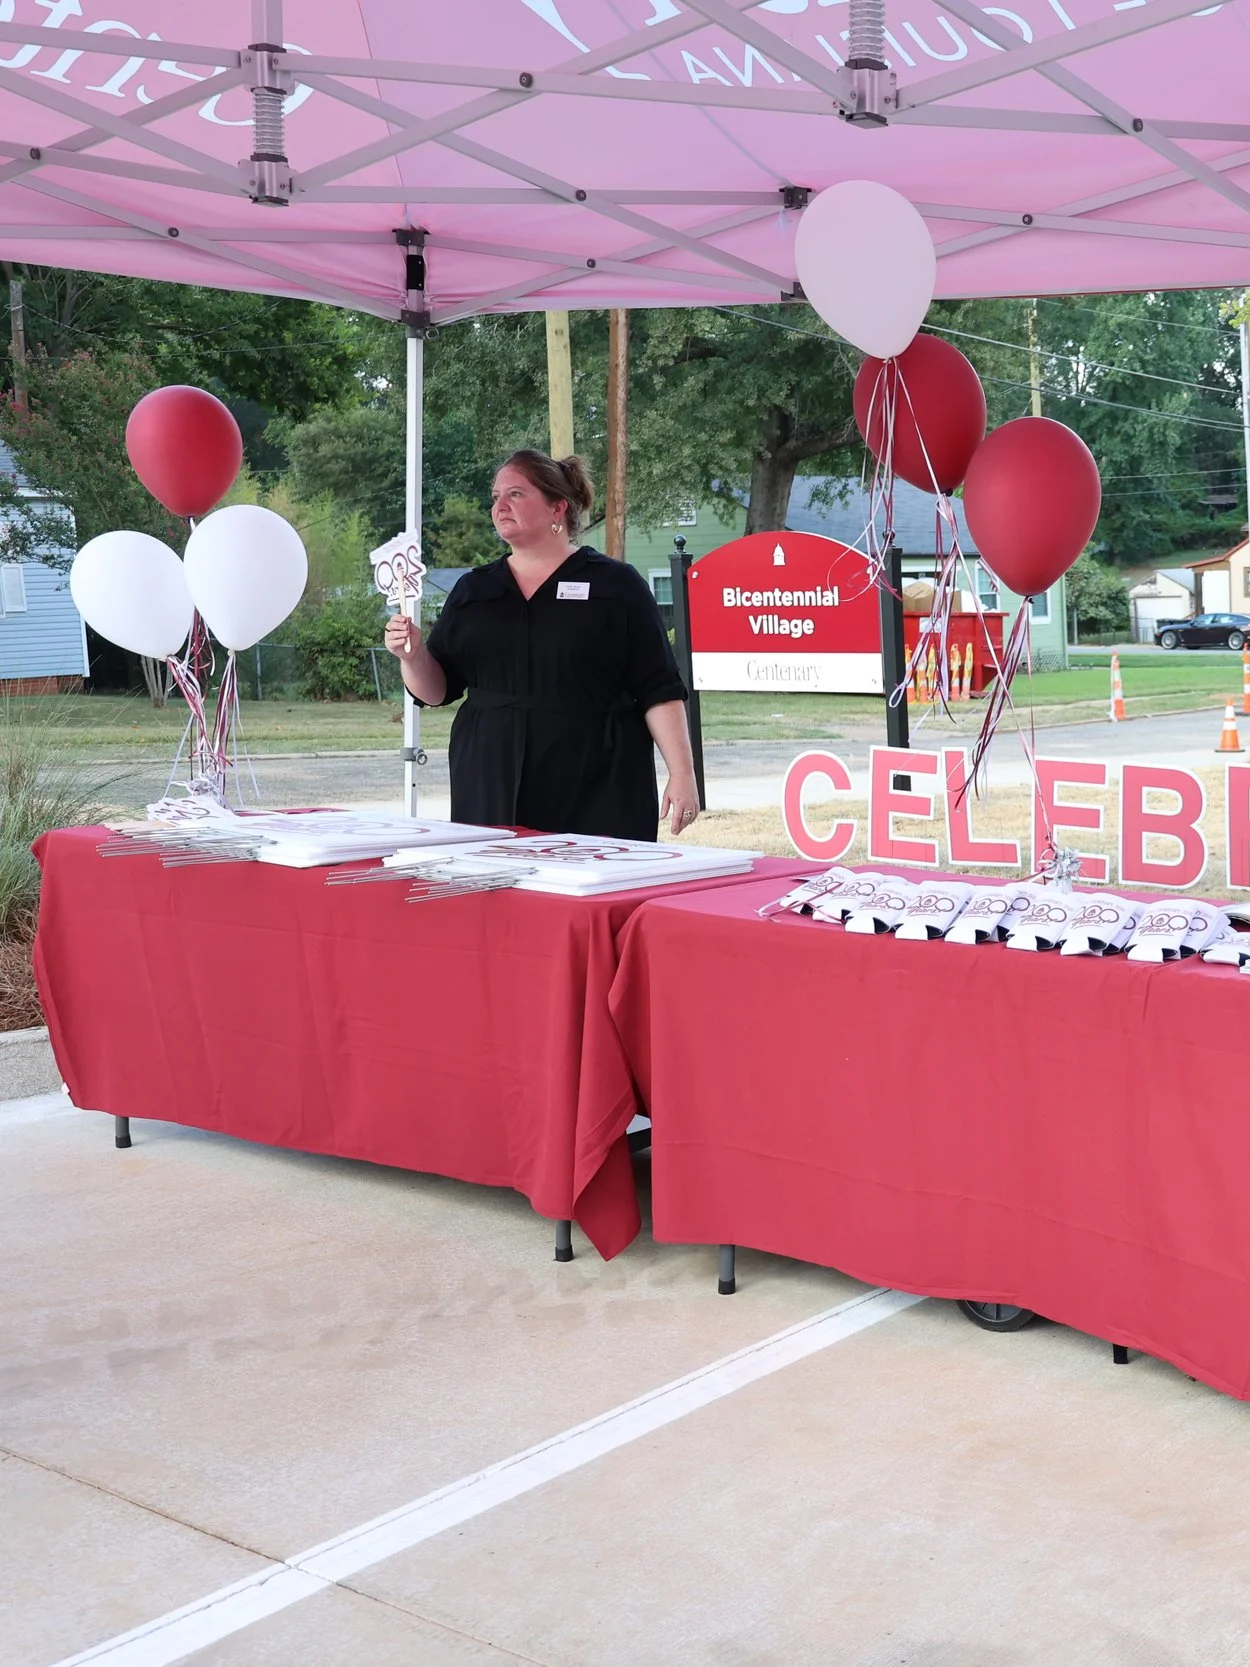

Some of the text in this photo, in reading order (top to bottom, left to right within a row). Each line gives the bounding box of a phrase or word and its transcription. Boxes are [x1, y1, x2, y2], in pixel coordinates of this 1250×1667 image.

[722, 586, 839, 607] Bicentennial
[748, 615, 814, 638] Village
[746, 660, 822, 688] Centenary
[1138, 913, 1189, 930] 200
